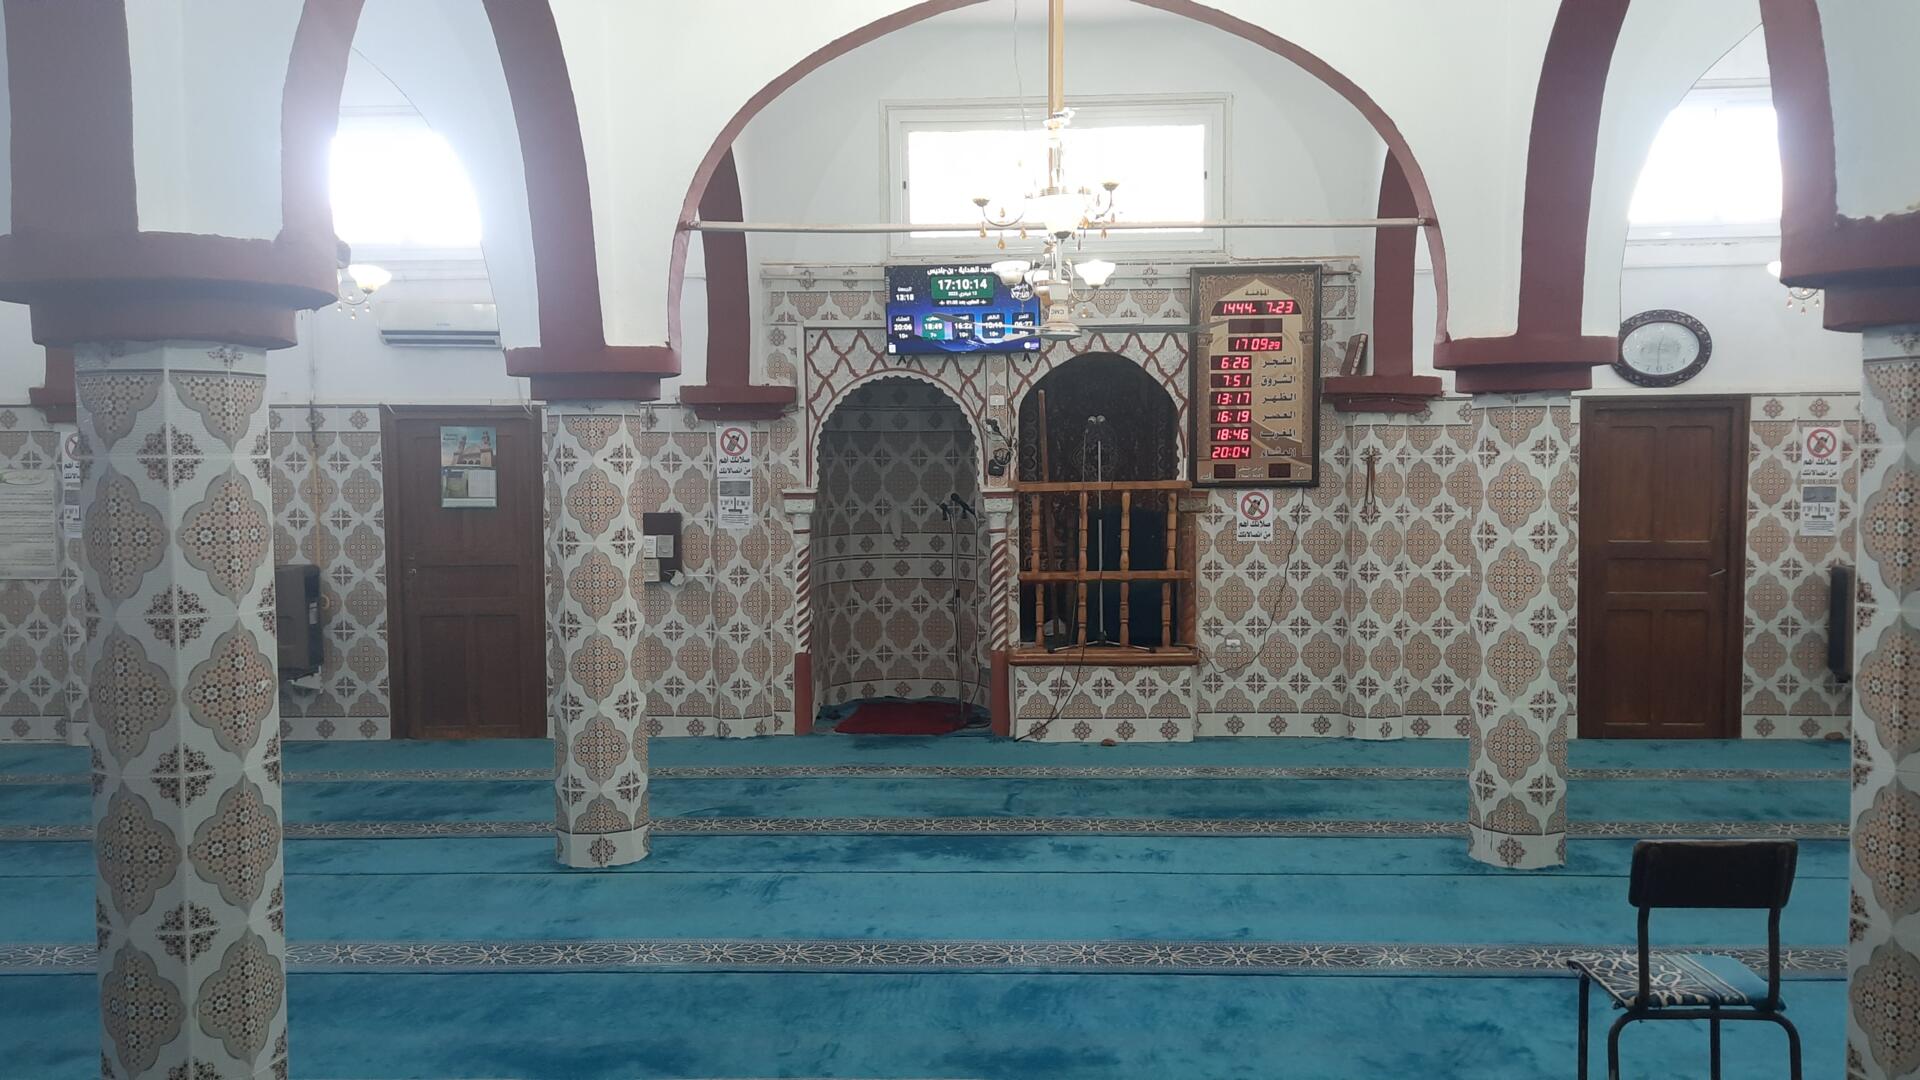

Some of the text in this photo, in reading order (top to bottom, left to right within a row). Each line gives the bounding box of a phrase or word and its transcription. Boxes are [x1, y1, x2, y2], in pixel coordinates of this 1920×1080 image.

[937, 278, 988, 290] 17:10:14
[1260, 374, 1296, 387] الشروق
[1216, 393, 1250, 405] 13:17
[1216, 411, 1250, 422] 16:19
[1262, 410, 1296, 422] العصر
[1216, 429, 1249, 440] 18:46
[1211, 446, 1250, 458] 20:04
